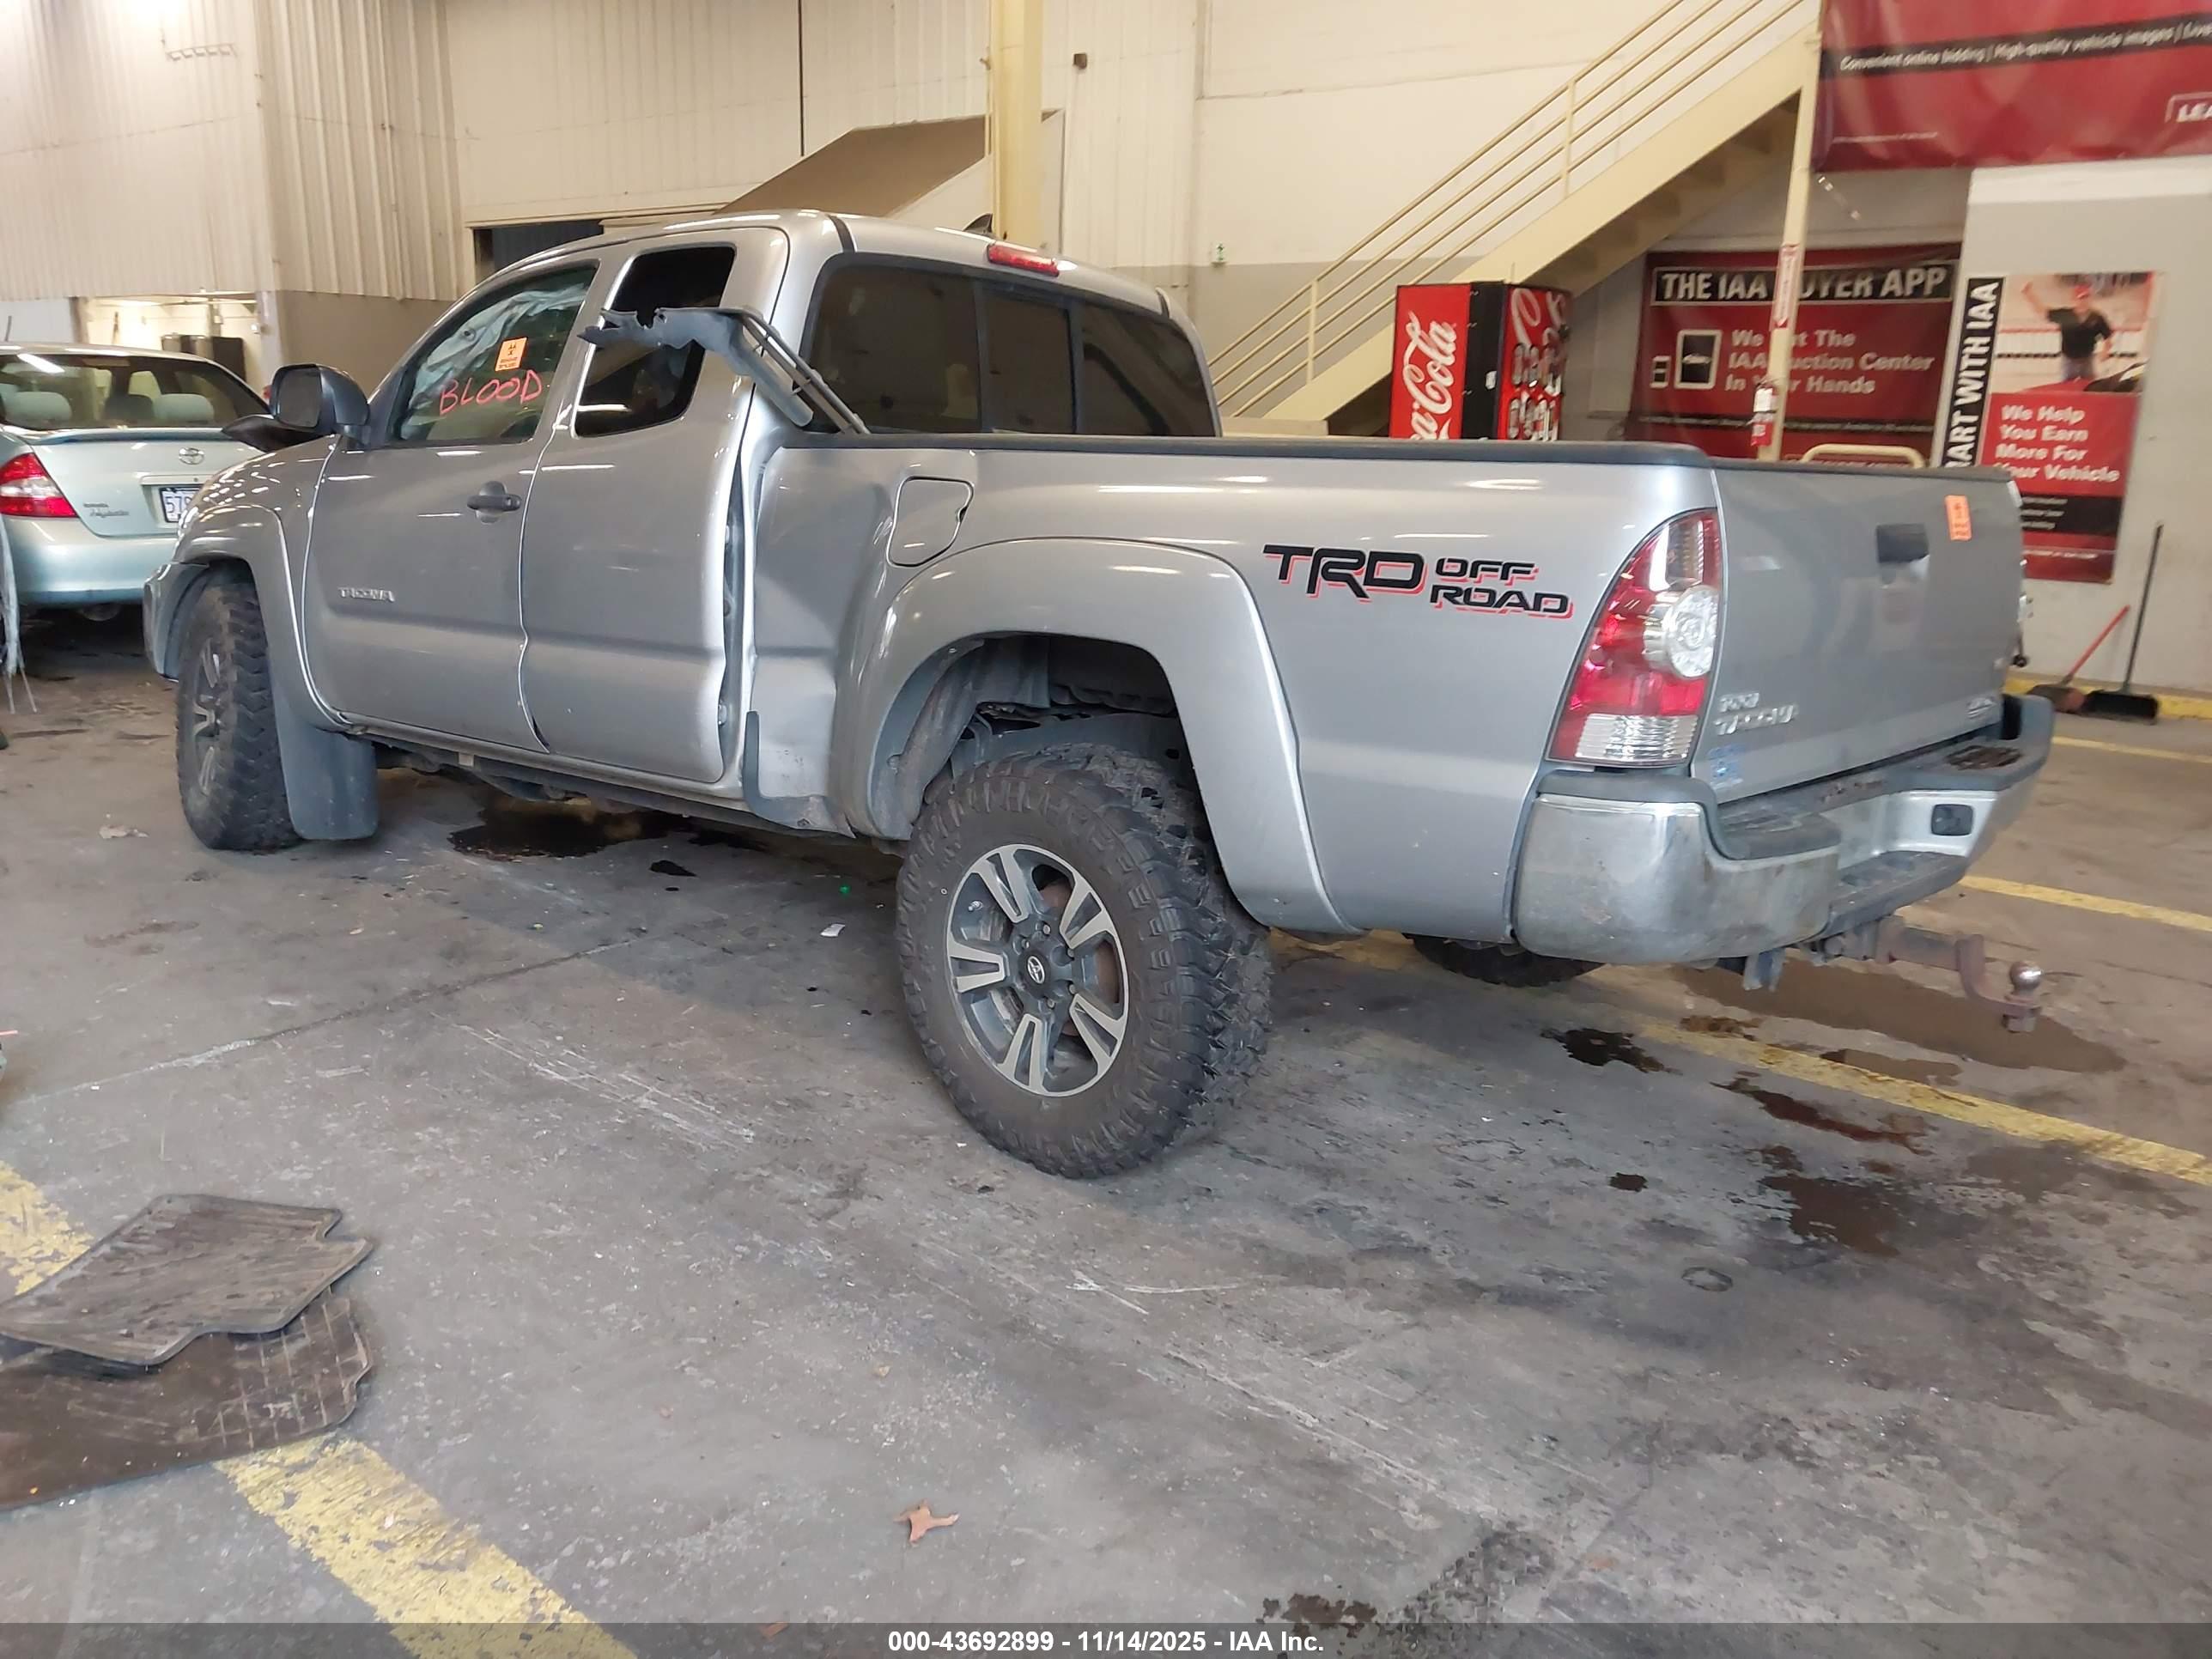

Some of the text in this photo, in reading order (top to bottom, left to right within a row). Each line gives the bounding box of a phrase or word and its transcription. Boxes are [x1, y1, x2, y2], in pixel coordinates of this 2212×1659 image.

[1662, 272, 1712, 300] THE
[1718, 273, 1768, 300] IAA
[1800, 271, 1875, 299] UYER
[1880, 267, 1948, 297] APP
[1966, 281, 1999, 330] IAA
[1731, 329, 1765, 347] We
[1814, 329, 1856, 347] The
[1729, 351, 1935, 371] IAA uction Center
[1954, 336, 1991, 406] WITH
[440, 369, 543, 416] BLOOD
[1724, 374, 1747, 392] In
[1806, 375, 1876, 394] Hands
[2002, 404, 2086, 425] We Help
[1944, 410, 1979, 467] ART
[1999, 424, 2089, 441] You Earn
[1995, 443, 2088, 461] More For
[2044, 464, 2121, 482] Vehicle
[1262, 544, 1540, 604] TRD OFF
[1431, 585, 1573, 619] ROAD
